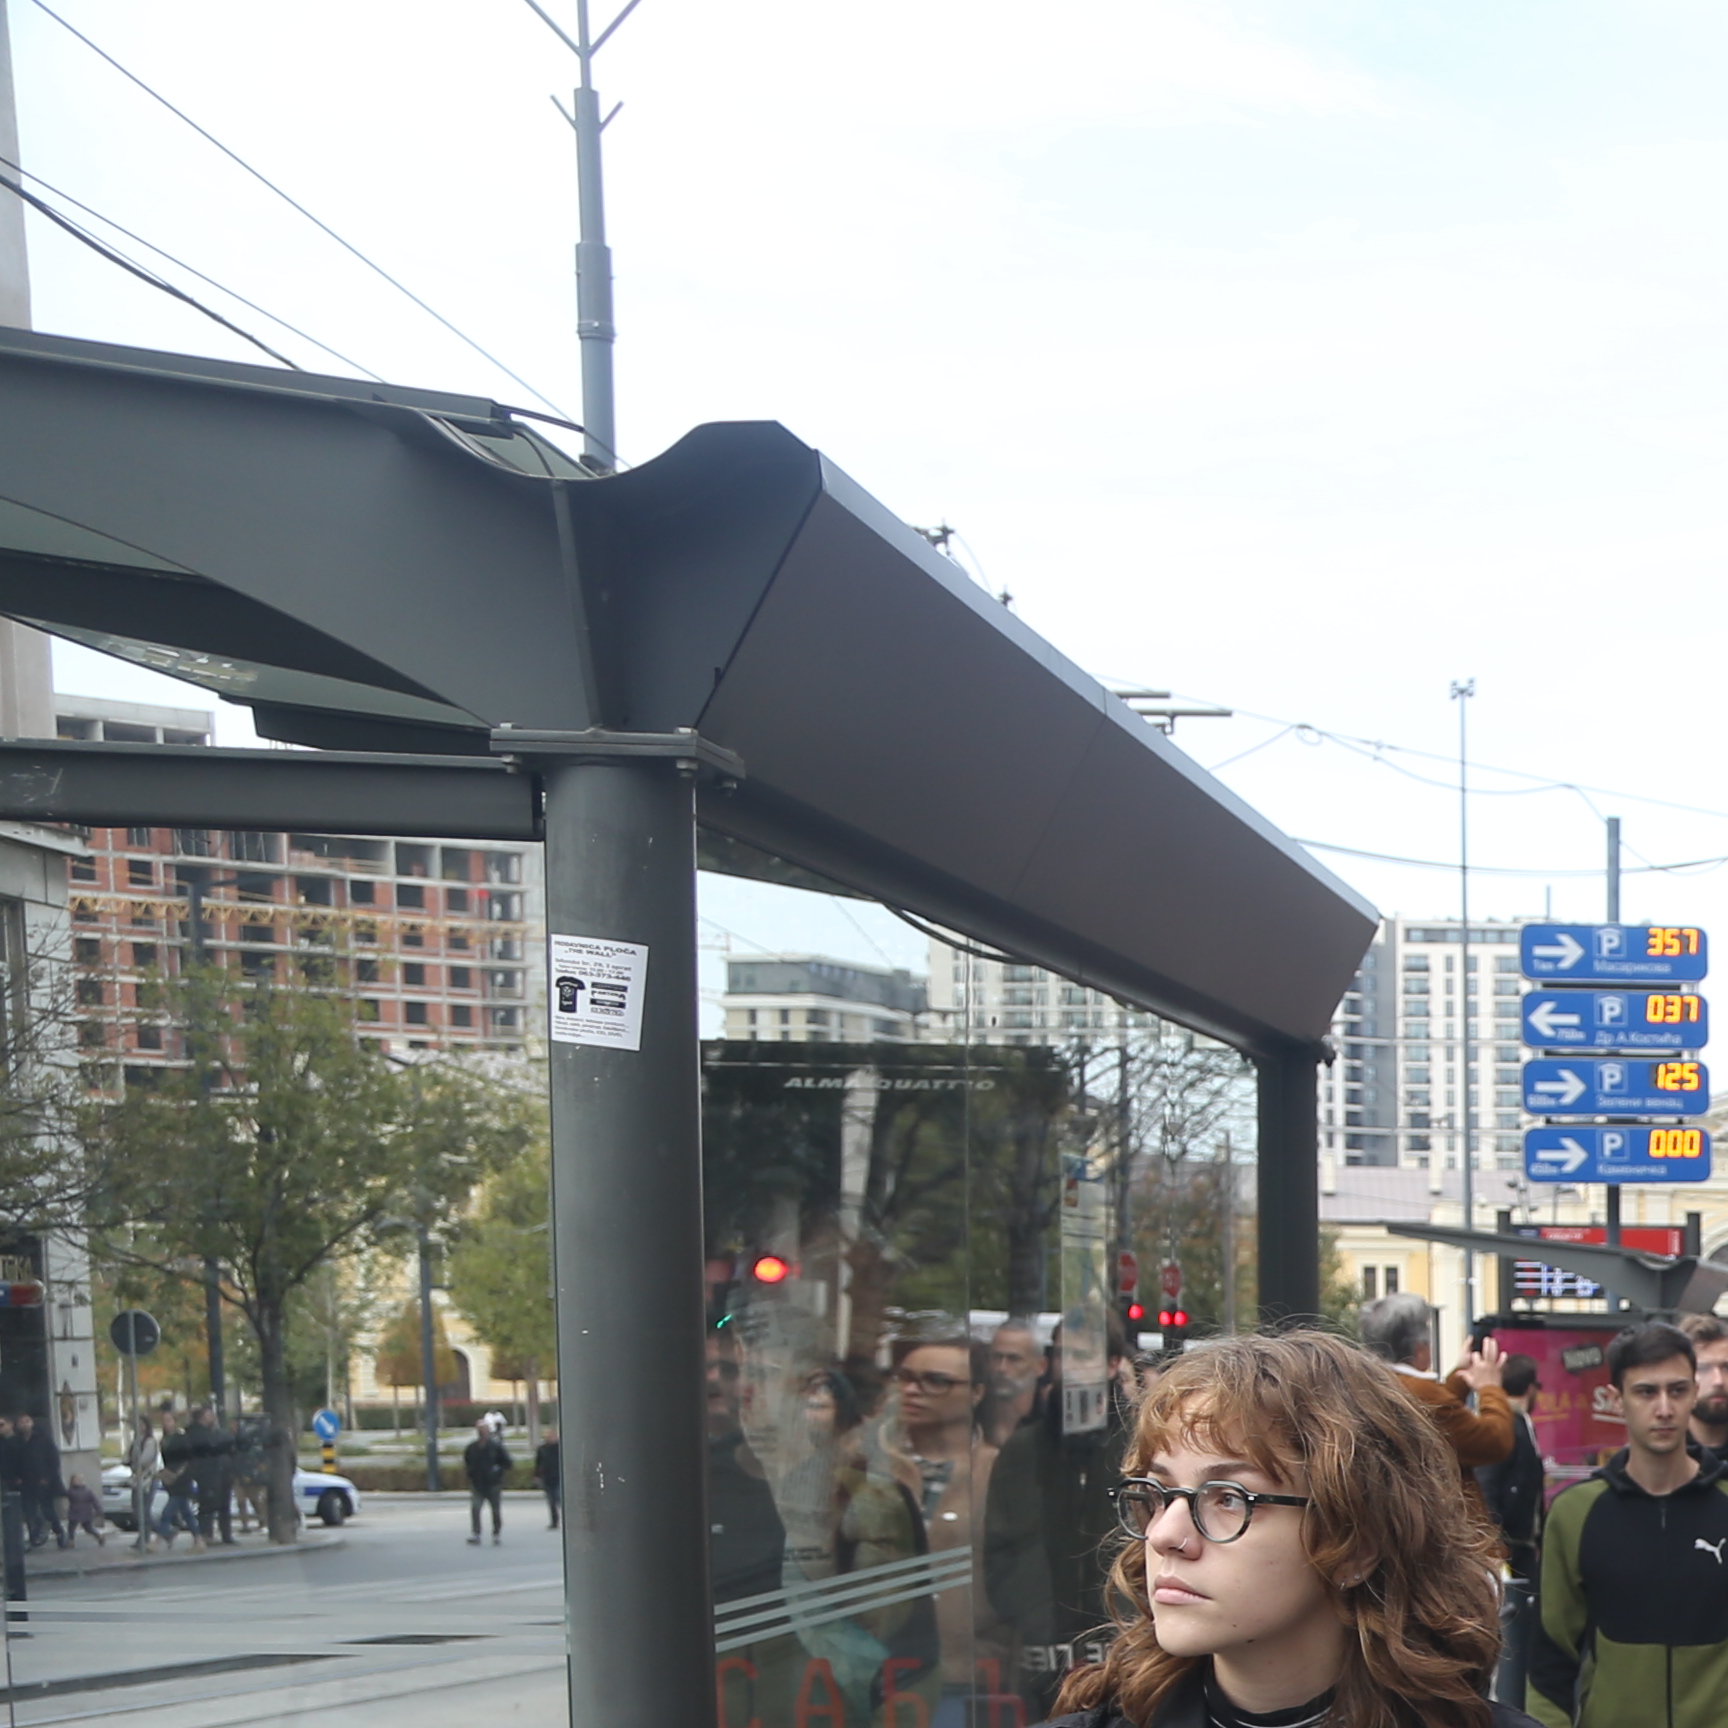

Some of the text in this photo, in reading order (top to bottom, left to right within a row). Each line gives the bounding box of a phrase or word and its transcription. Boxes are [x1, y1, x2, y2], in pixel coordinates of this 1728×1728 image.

[1647, 927, 1699, 957] 357
[1646, 995, 1700, 1024] 037
[1657, 1062, 1699, 1091] 125
[1649, 1129, 1701, 1159] 000
